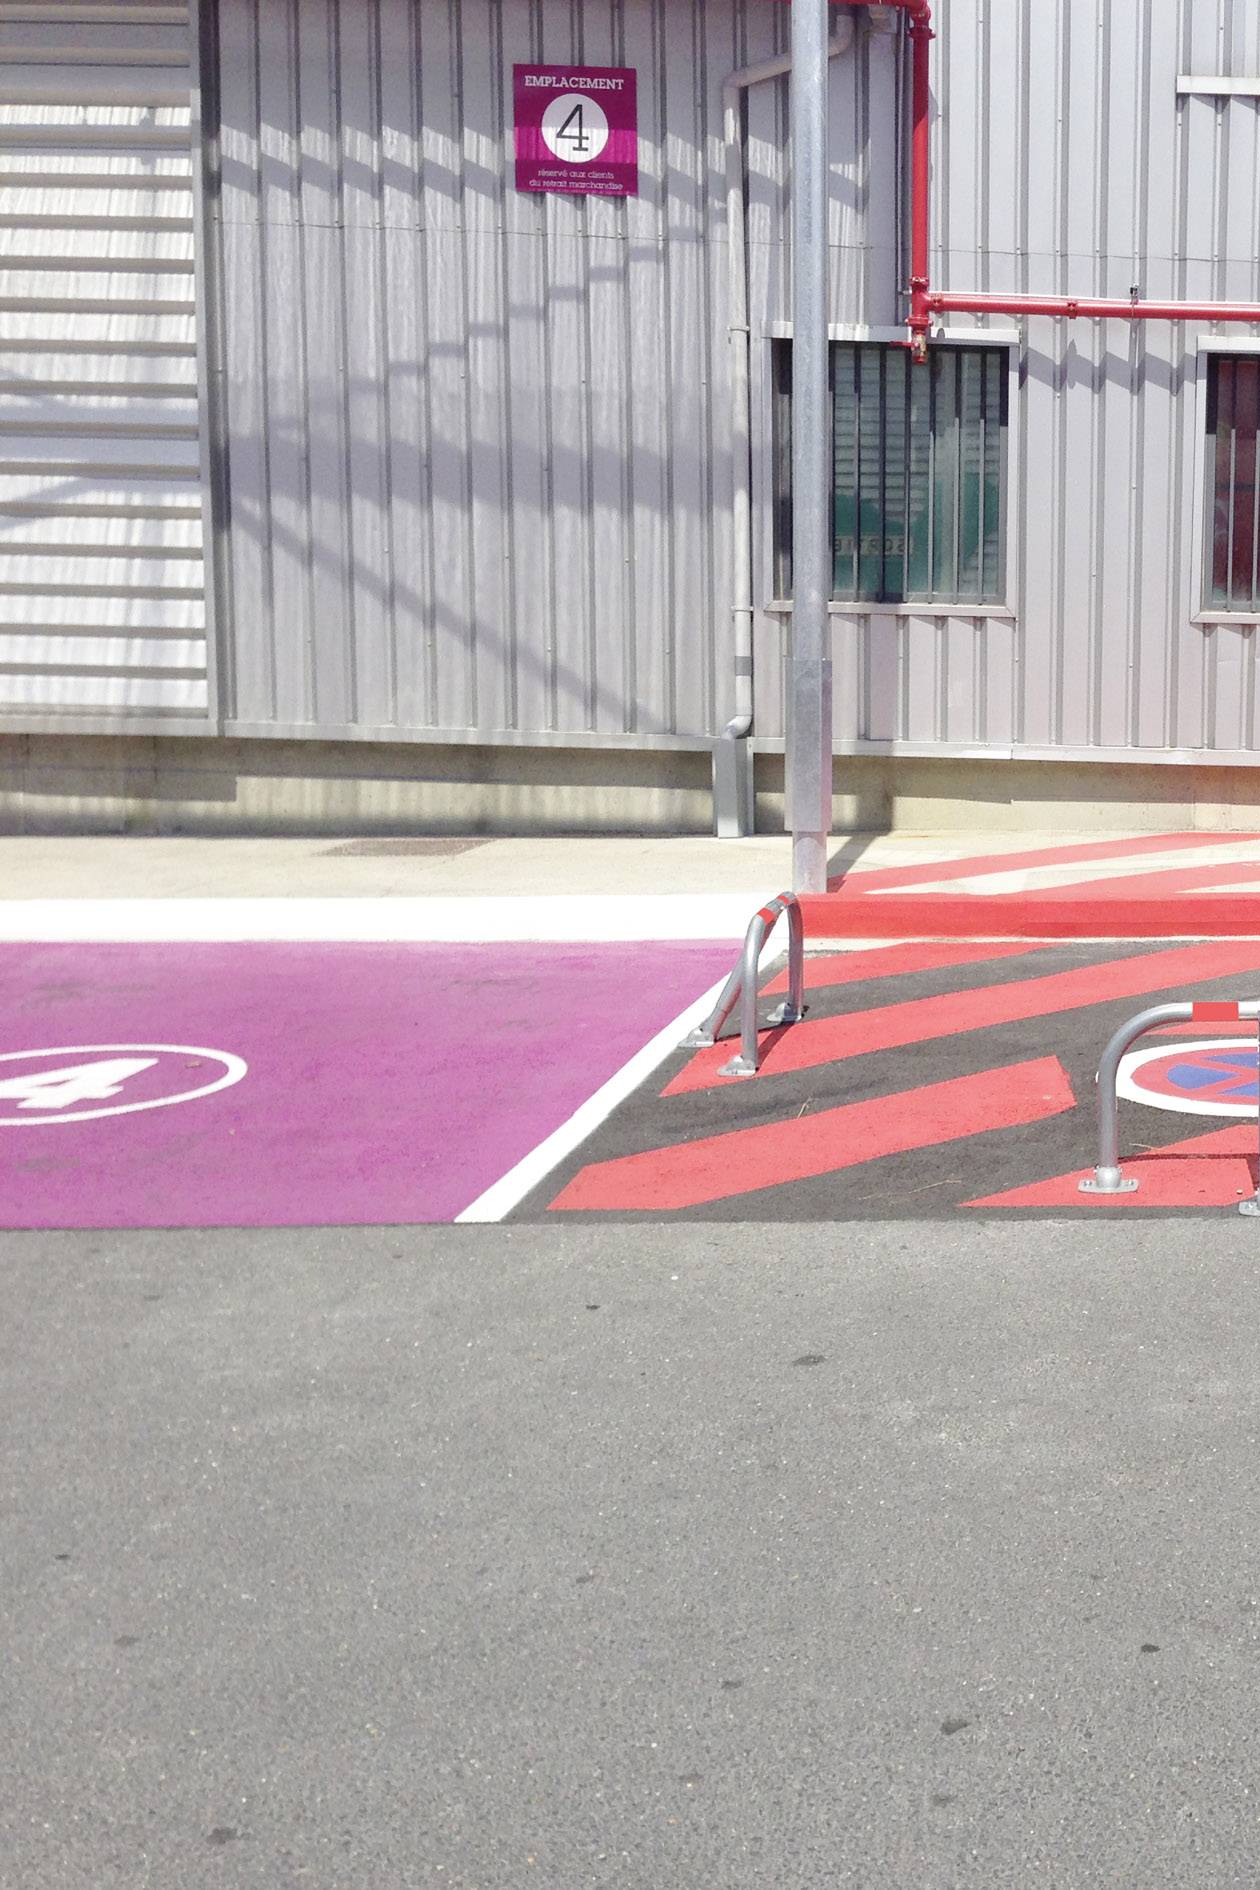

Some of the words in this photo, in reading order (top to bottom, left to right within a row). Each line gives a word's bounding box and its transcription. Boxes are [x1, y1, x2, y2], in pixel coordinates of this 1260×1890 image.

[524, 75, 625, 90] EMPLACEMENT
[556, 103, 589, 152] 4
[538, 169, 568, 178] réservé
[569, 171, 586, 179] aux
[588, 170, 615, 180] clients
[529, 179, 541, 187] du
[543, 180, 567, 188] retrait
[569, 181, 624, 191] marchandise
